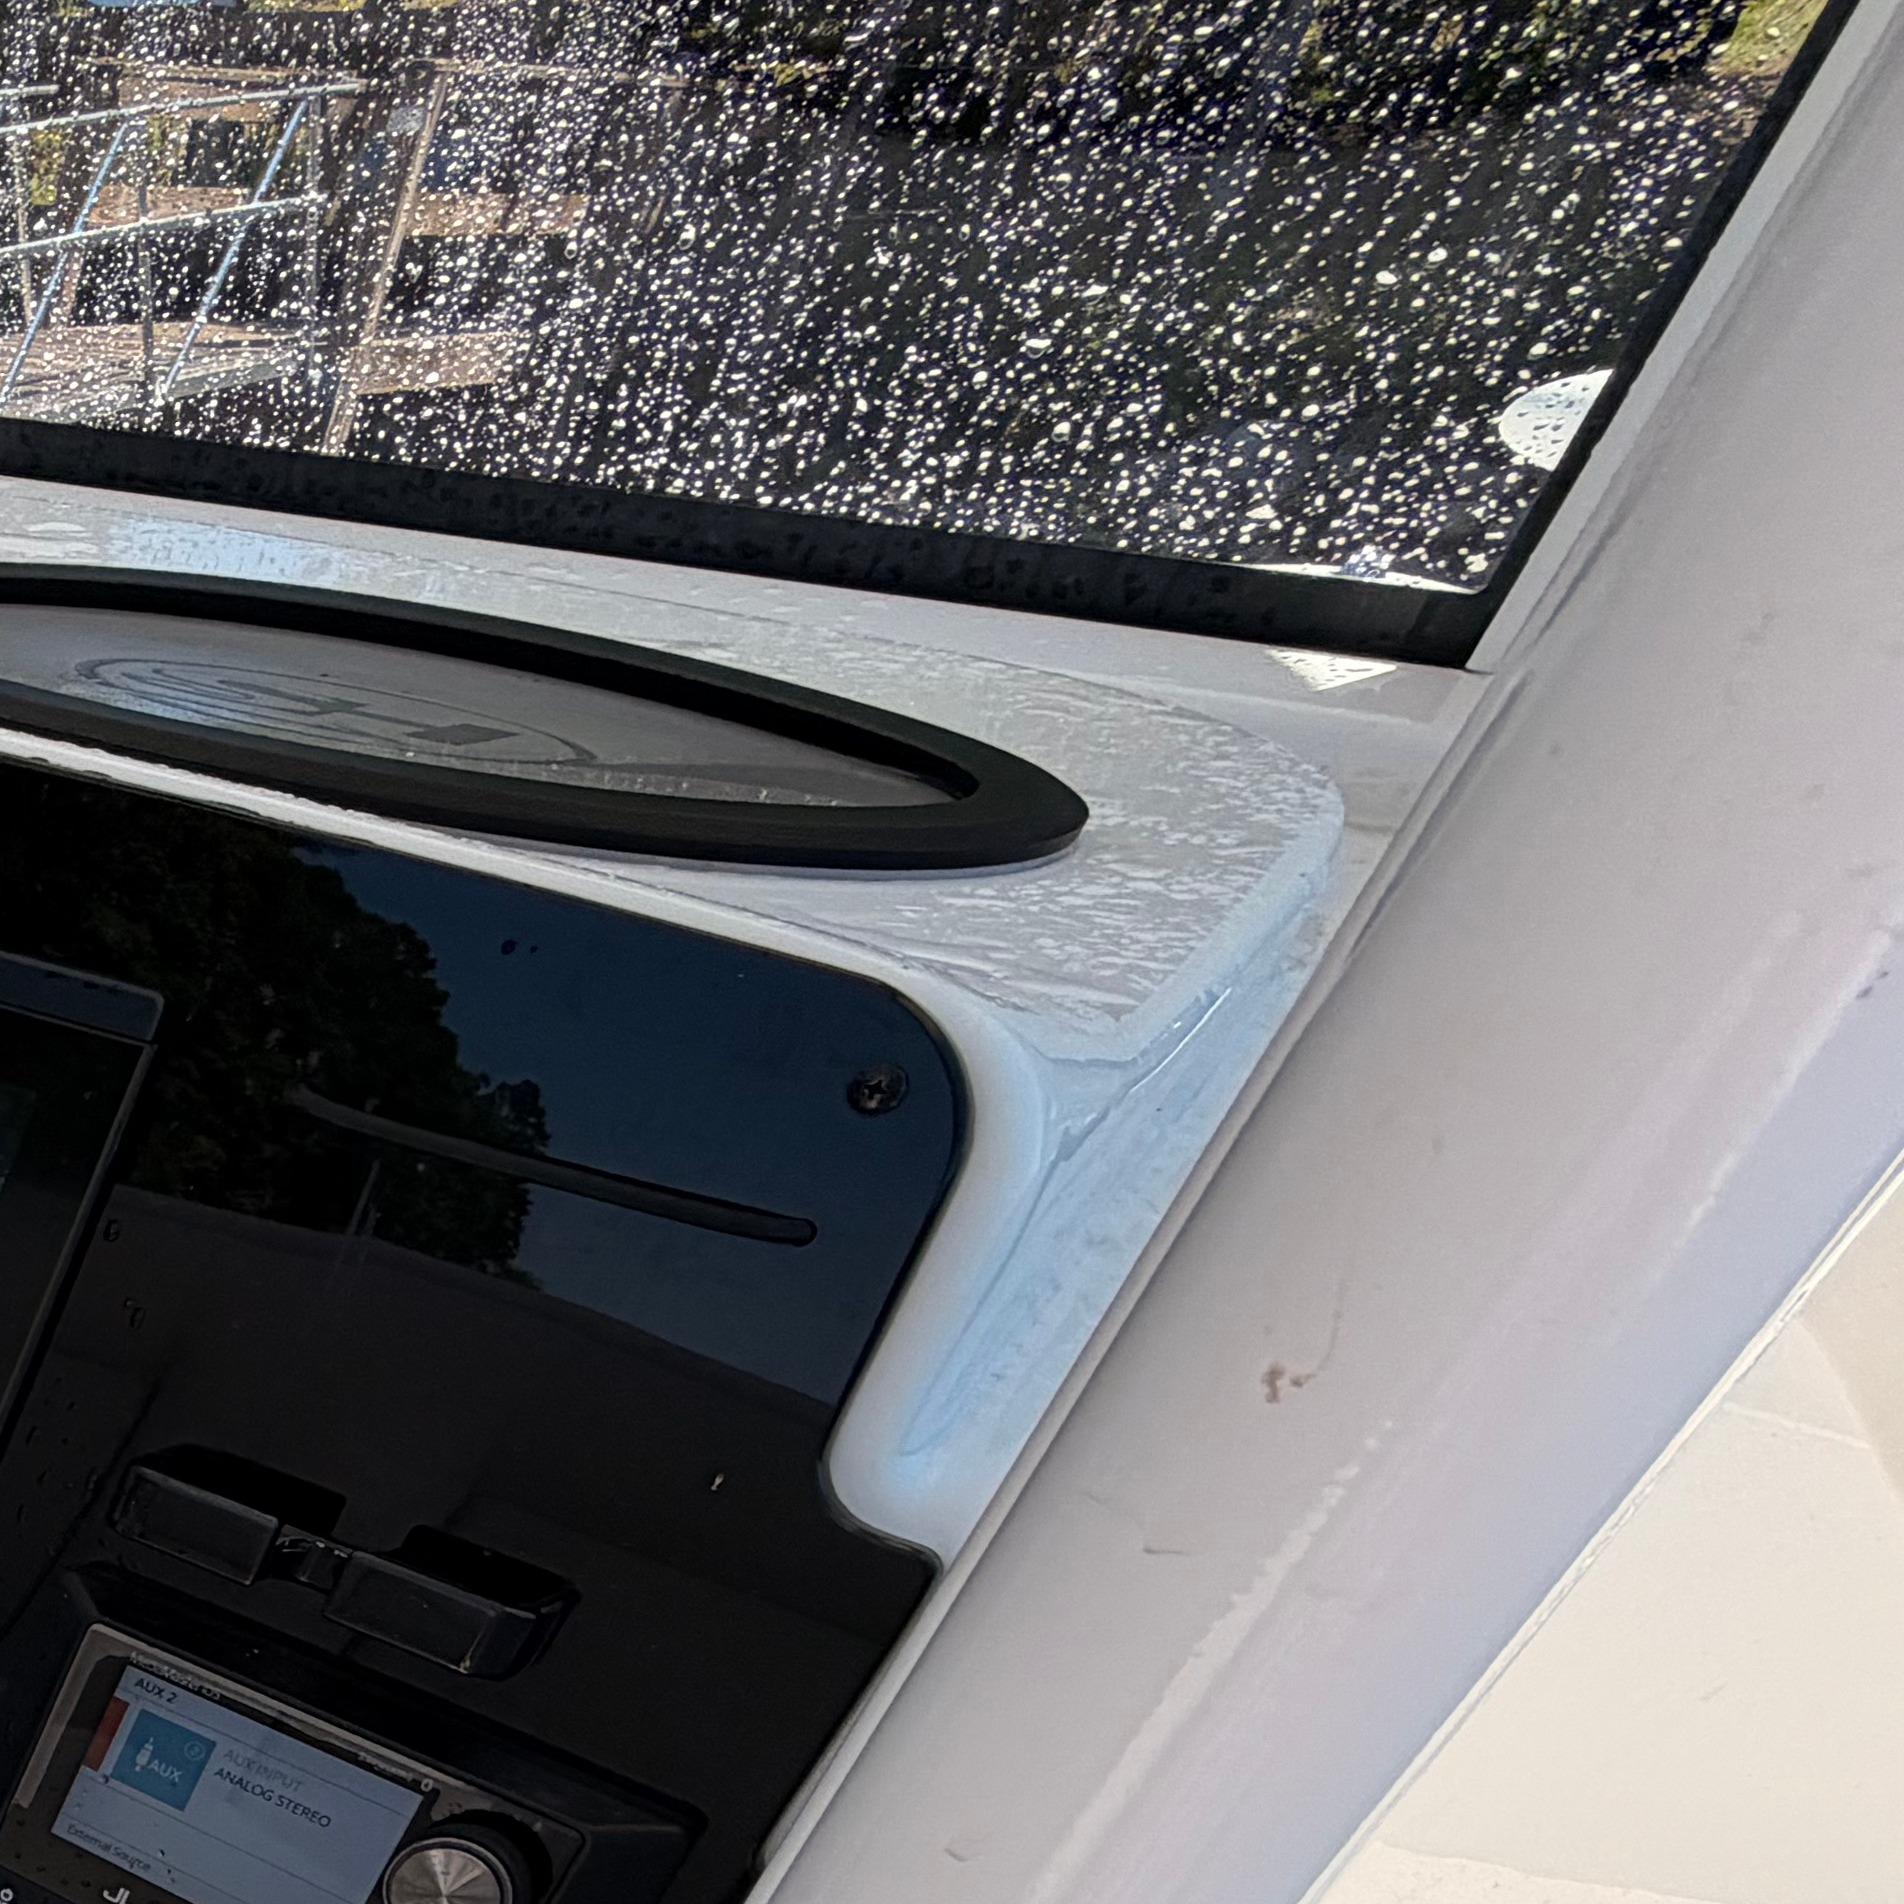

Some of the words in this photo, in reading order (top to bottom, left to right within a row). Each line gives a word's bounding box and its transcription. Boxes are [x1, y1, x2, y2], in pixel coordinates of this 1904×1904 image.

[134, 1677, 165, 1699] AUX
[166, 1692, 179, 1704] 2
[149, 1759, 185, 1783] AUX
[223, 1748, 255, 1773] AUX
[213, 1767, 274, 1803] ANALOG
[274, 1794, 332, 1829] STEREO
[67, 1823, 113, 1852] External
[112, 1846, 152, 1871] Source
